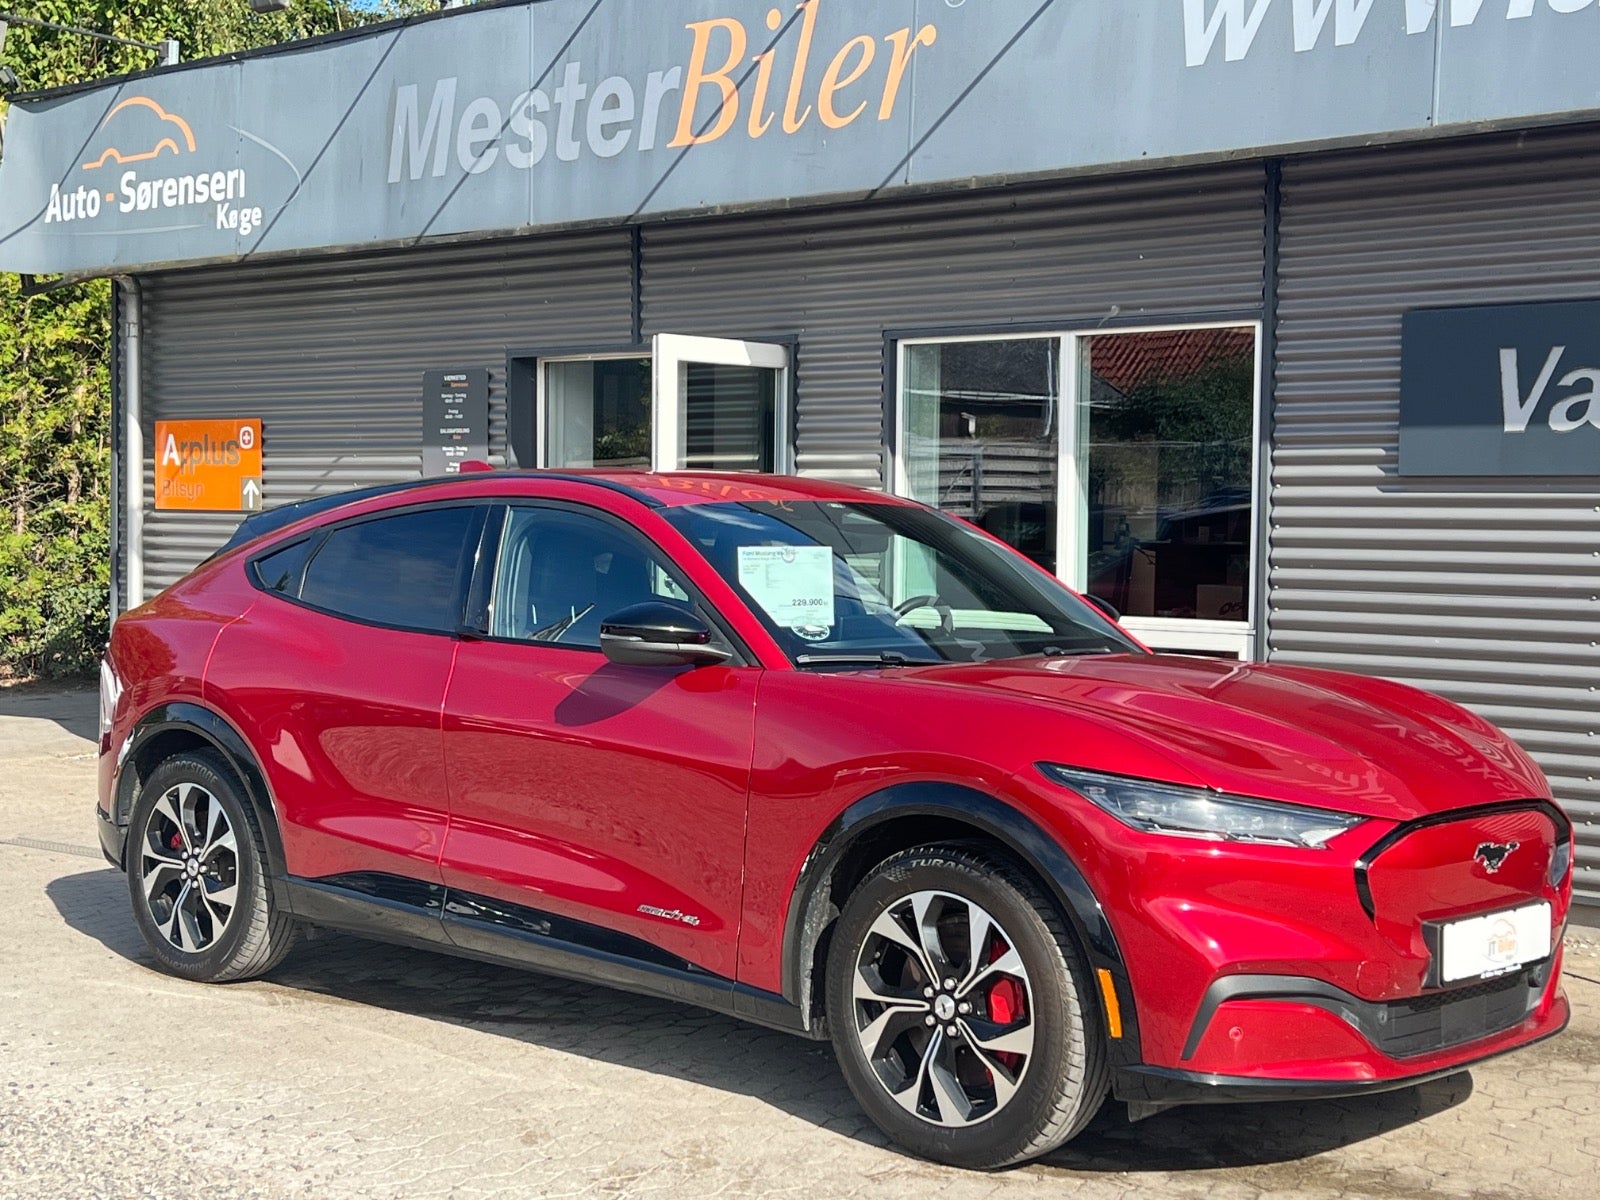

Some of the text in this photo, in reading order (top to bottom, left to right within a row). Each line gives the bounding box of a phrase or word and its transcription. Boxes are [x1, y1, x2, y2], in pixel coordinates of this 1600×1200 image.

[45, 184, 99, 223] Auto
[120, 168, 245, 213] Sørensen
[216, 203, 262, 236] Køge
